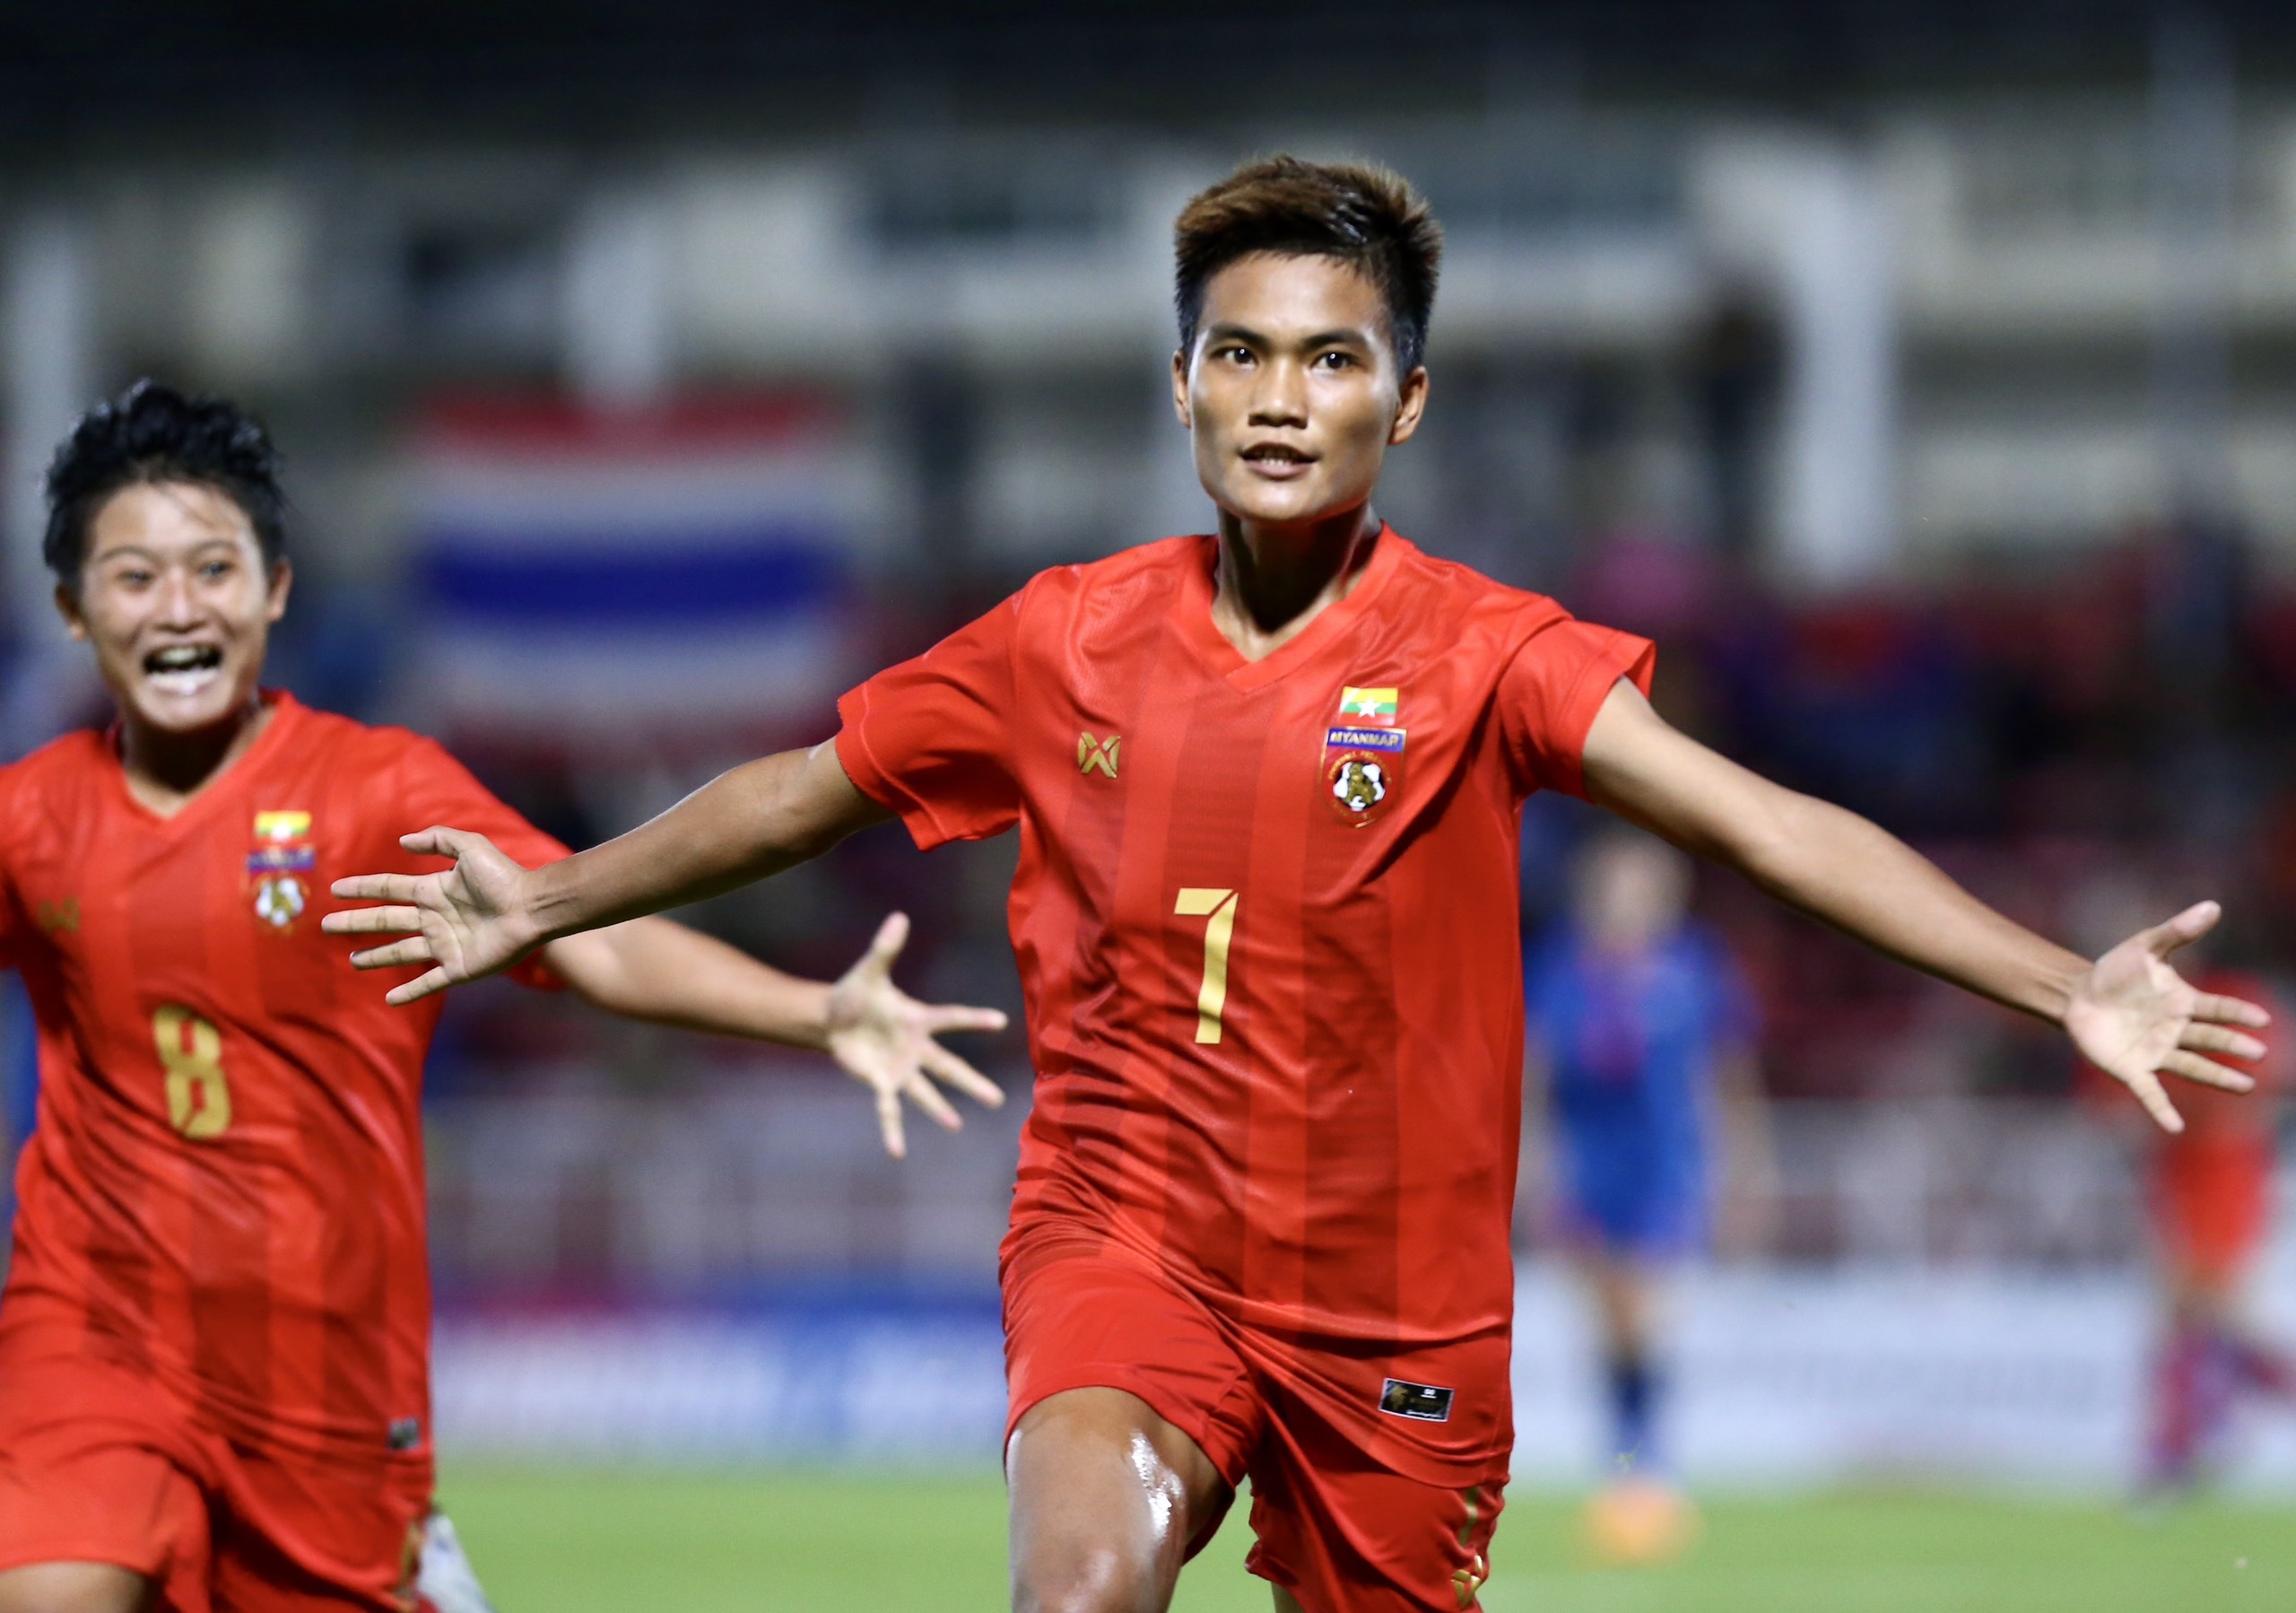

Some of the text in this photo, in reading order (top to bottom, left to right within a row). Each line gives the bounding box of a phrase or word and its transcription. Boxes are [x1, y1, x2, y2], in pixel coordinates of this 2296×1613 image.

[1330, 731, 1399, 746] MYANMAR
[1174, 887, 1239, 1044] 7
[153, 1003, 232, 1139] 8
